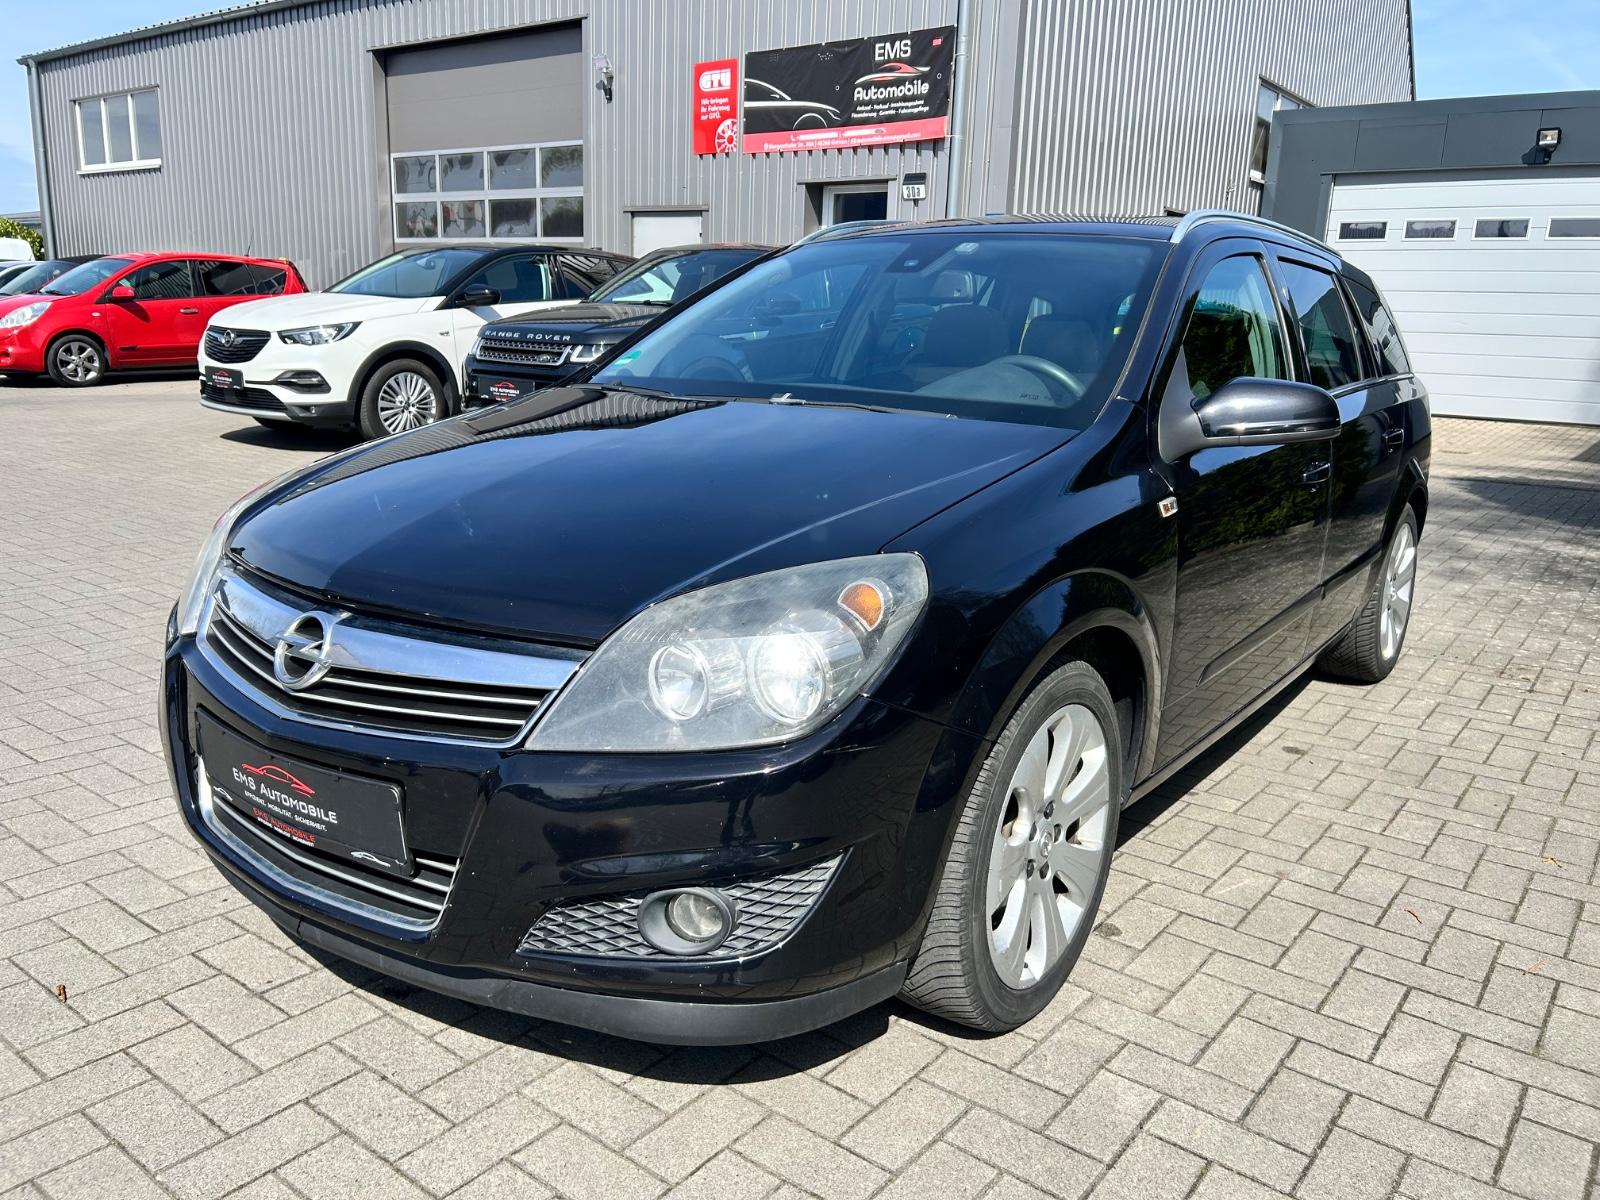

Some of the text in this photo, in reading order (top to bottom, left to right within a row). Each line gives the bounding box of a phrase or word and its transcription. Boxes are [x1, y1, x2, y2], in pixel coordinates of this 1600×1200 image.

[875, 40, 911, 61] EMS
[854, 80, 929, 101] Automobile
[485, 330, 571, 341] RANGE ROVER
[232, 767, 338, 824] EMS AUTOMOBILE
